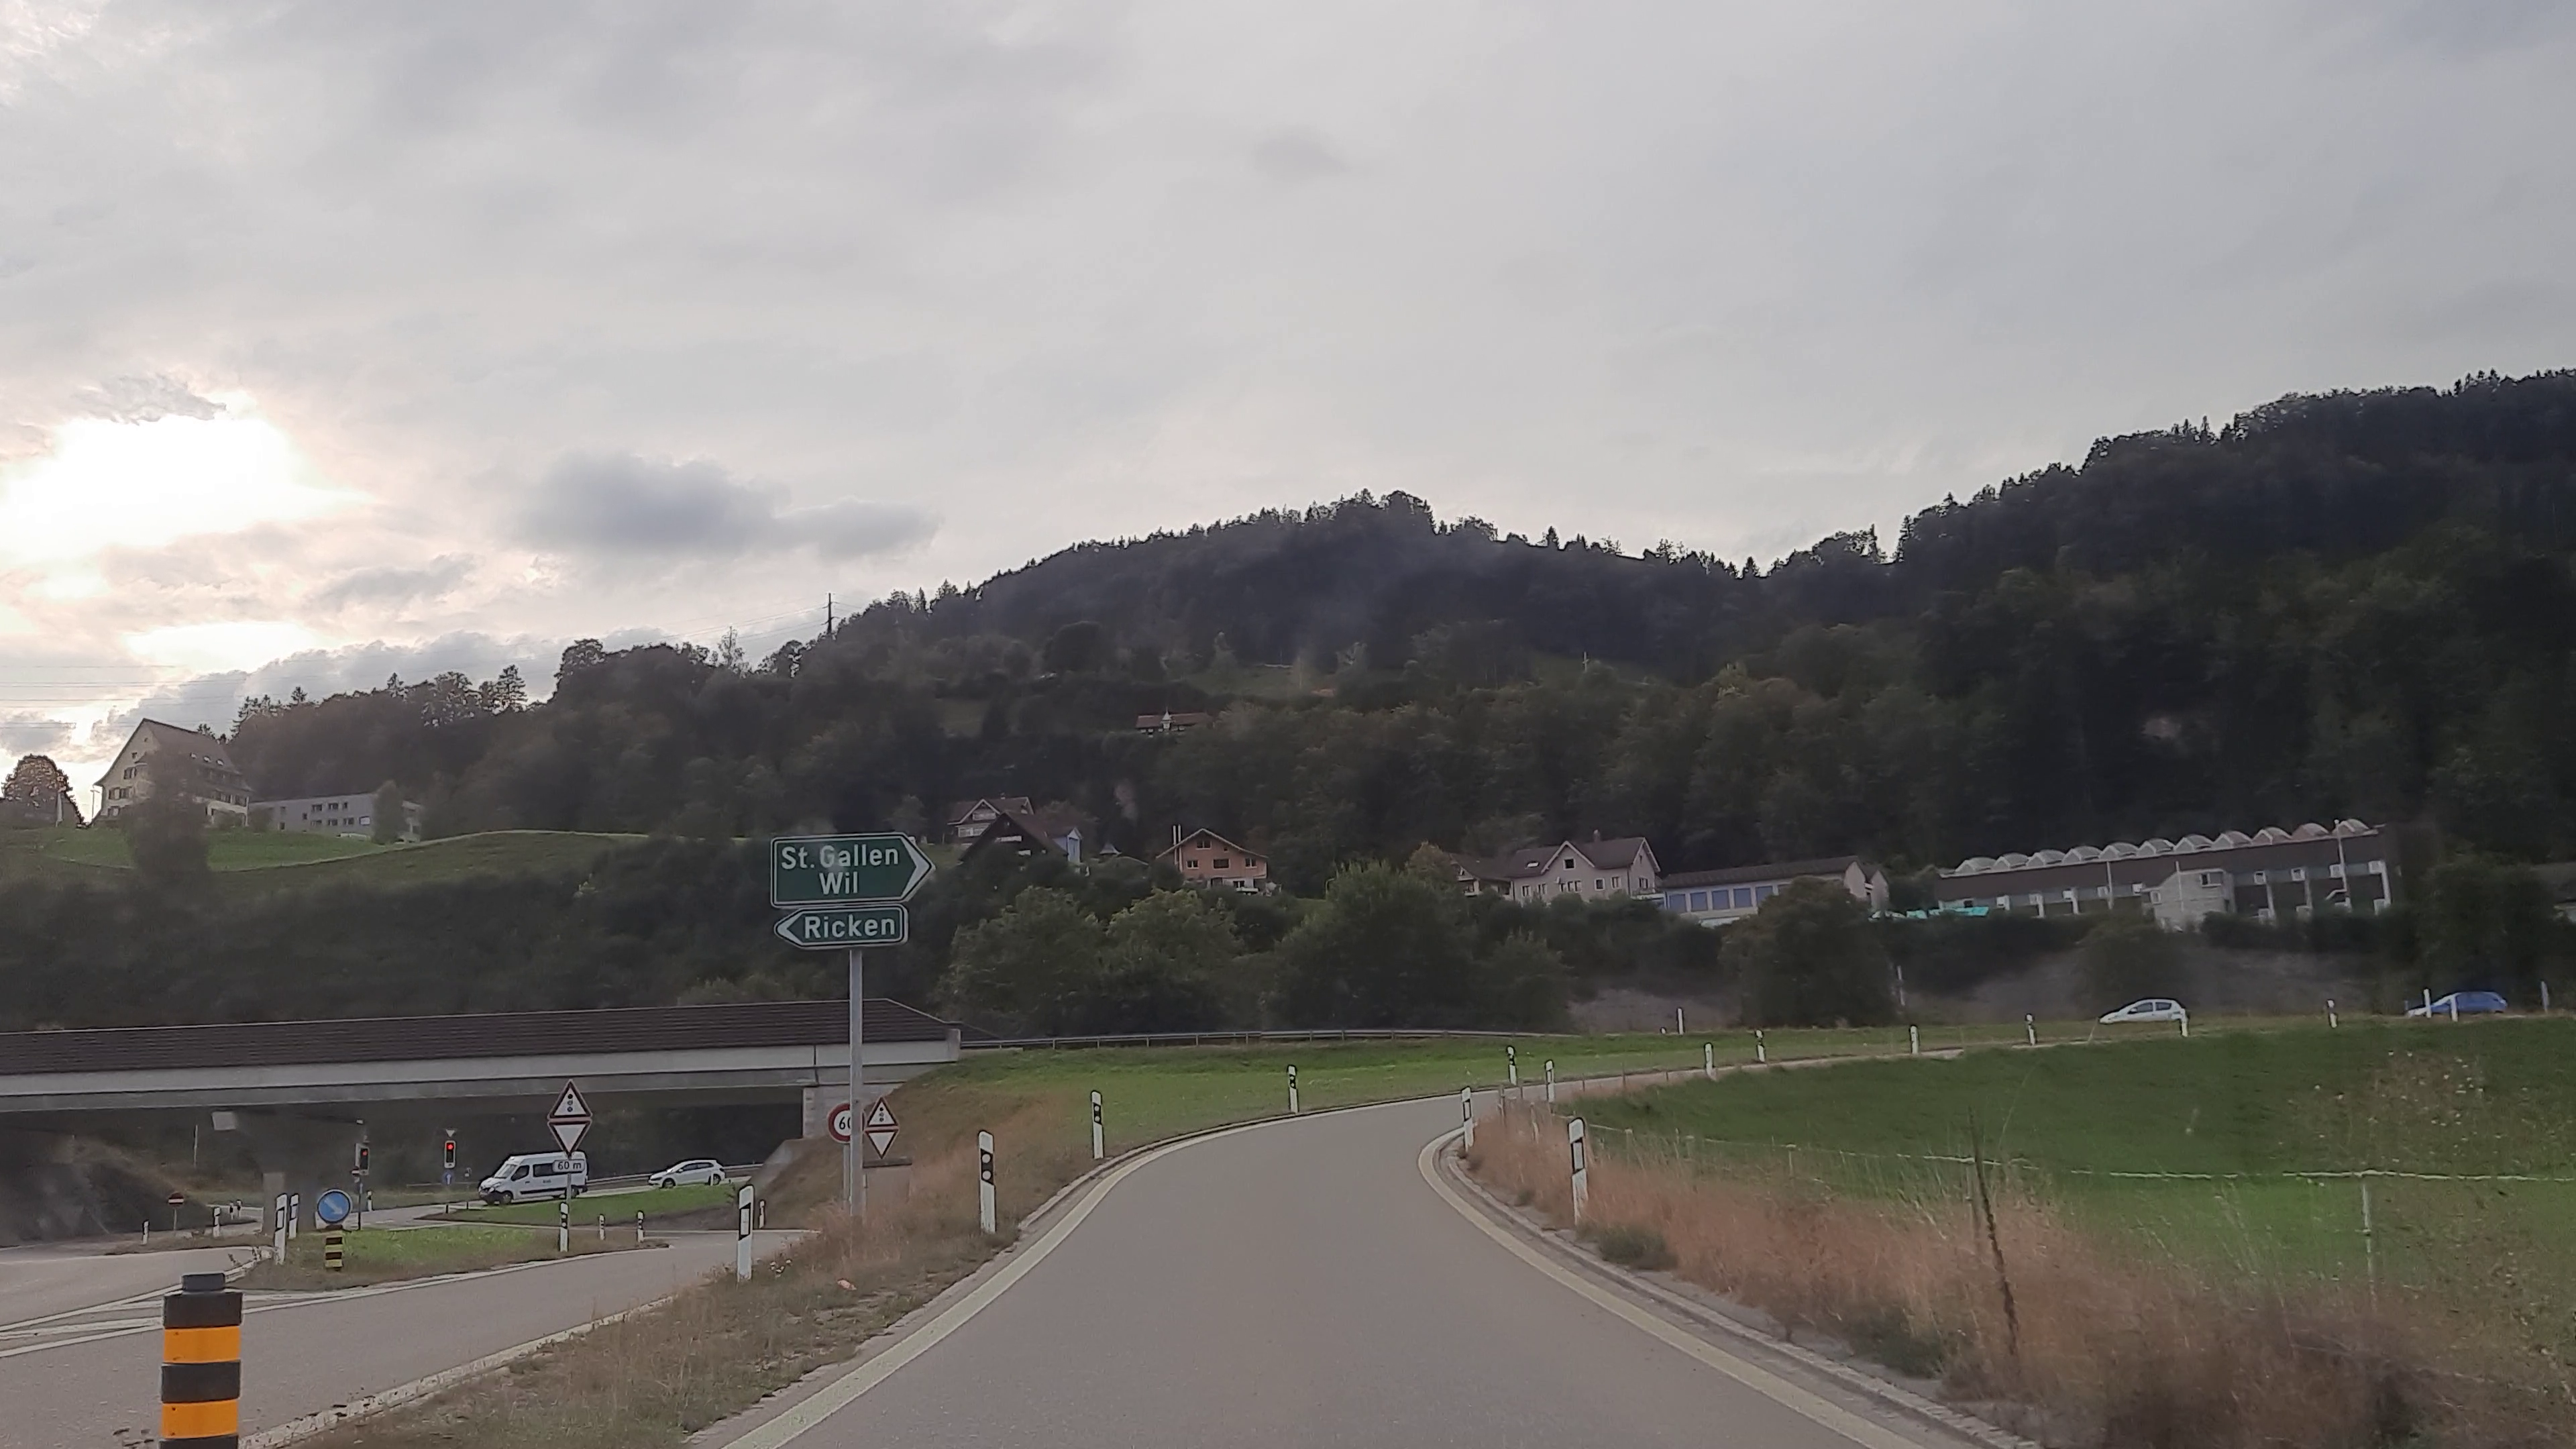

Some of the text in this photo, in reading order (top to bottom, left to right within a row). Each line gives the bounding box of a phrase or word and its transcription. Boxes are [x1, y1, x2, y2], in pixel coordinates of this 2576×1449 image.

[781, 844, 899, 869] St. Gallen
[818, 871, 859, 896] Wil
[804, 914, 896, 939] Ricken
[557, 1161, 570, 1170] 60
